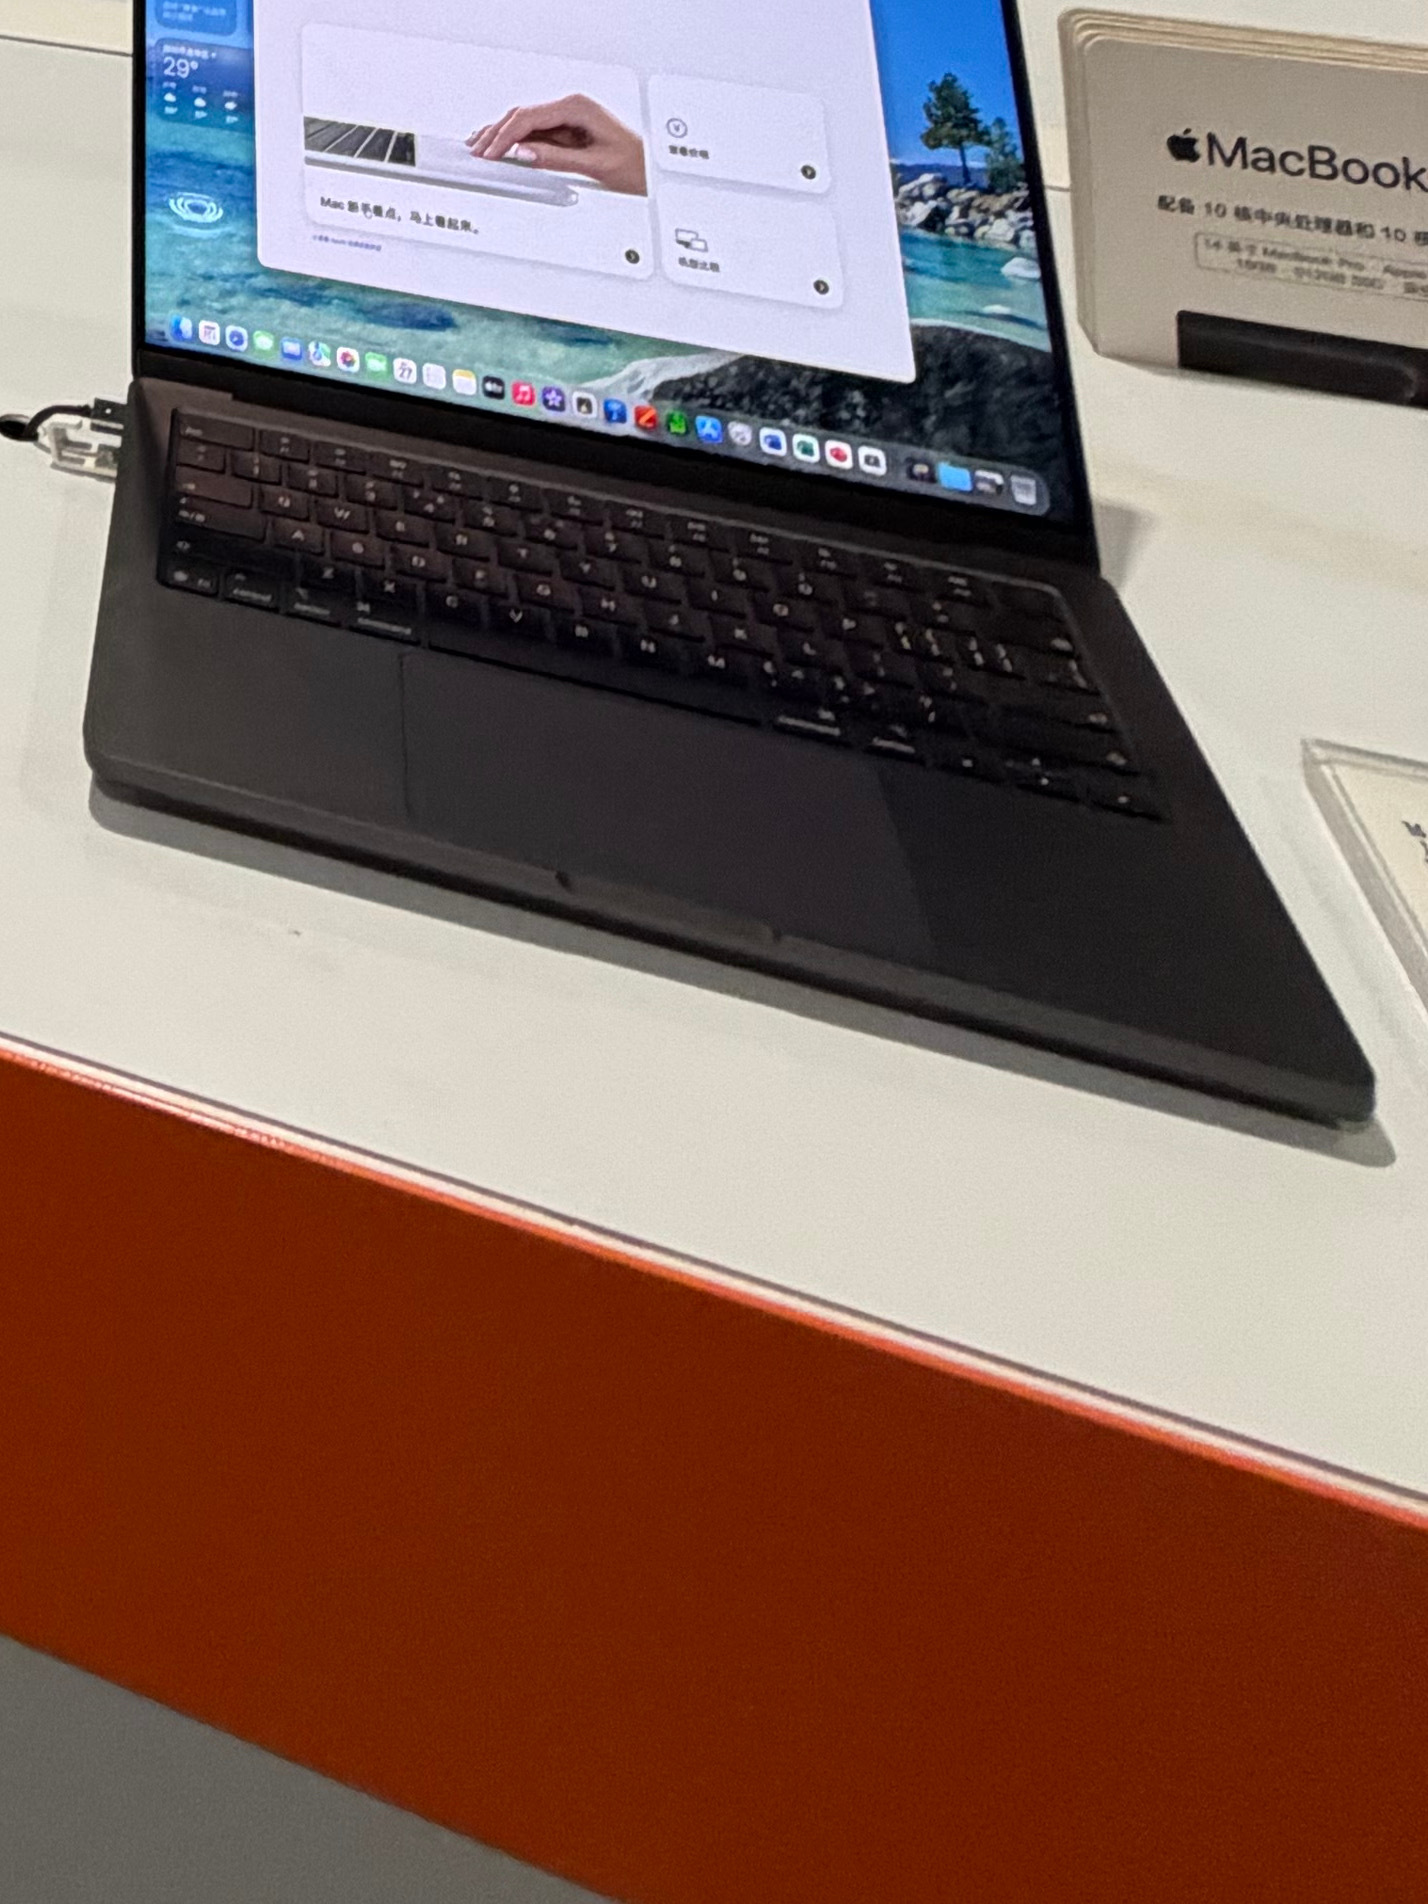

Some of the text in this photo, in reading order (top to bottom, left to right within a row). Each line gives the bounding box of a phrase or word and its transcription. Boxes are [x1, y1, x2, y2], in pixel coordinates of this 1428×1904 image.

[1205, 130, 1428, 195] MacBook
[319, 195, 345, 211] Mac
[1157, 194, 1195, 215] 配备
[1204, 201, 1228, 219] 10
[1380, 226, 1407, 244] 10
